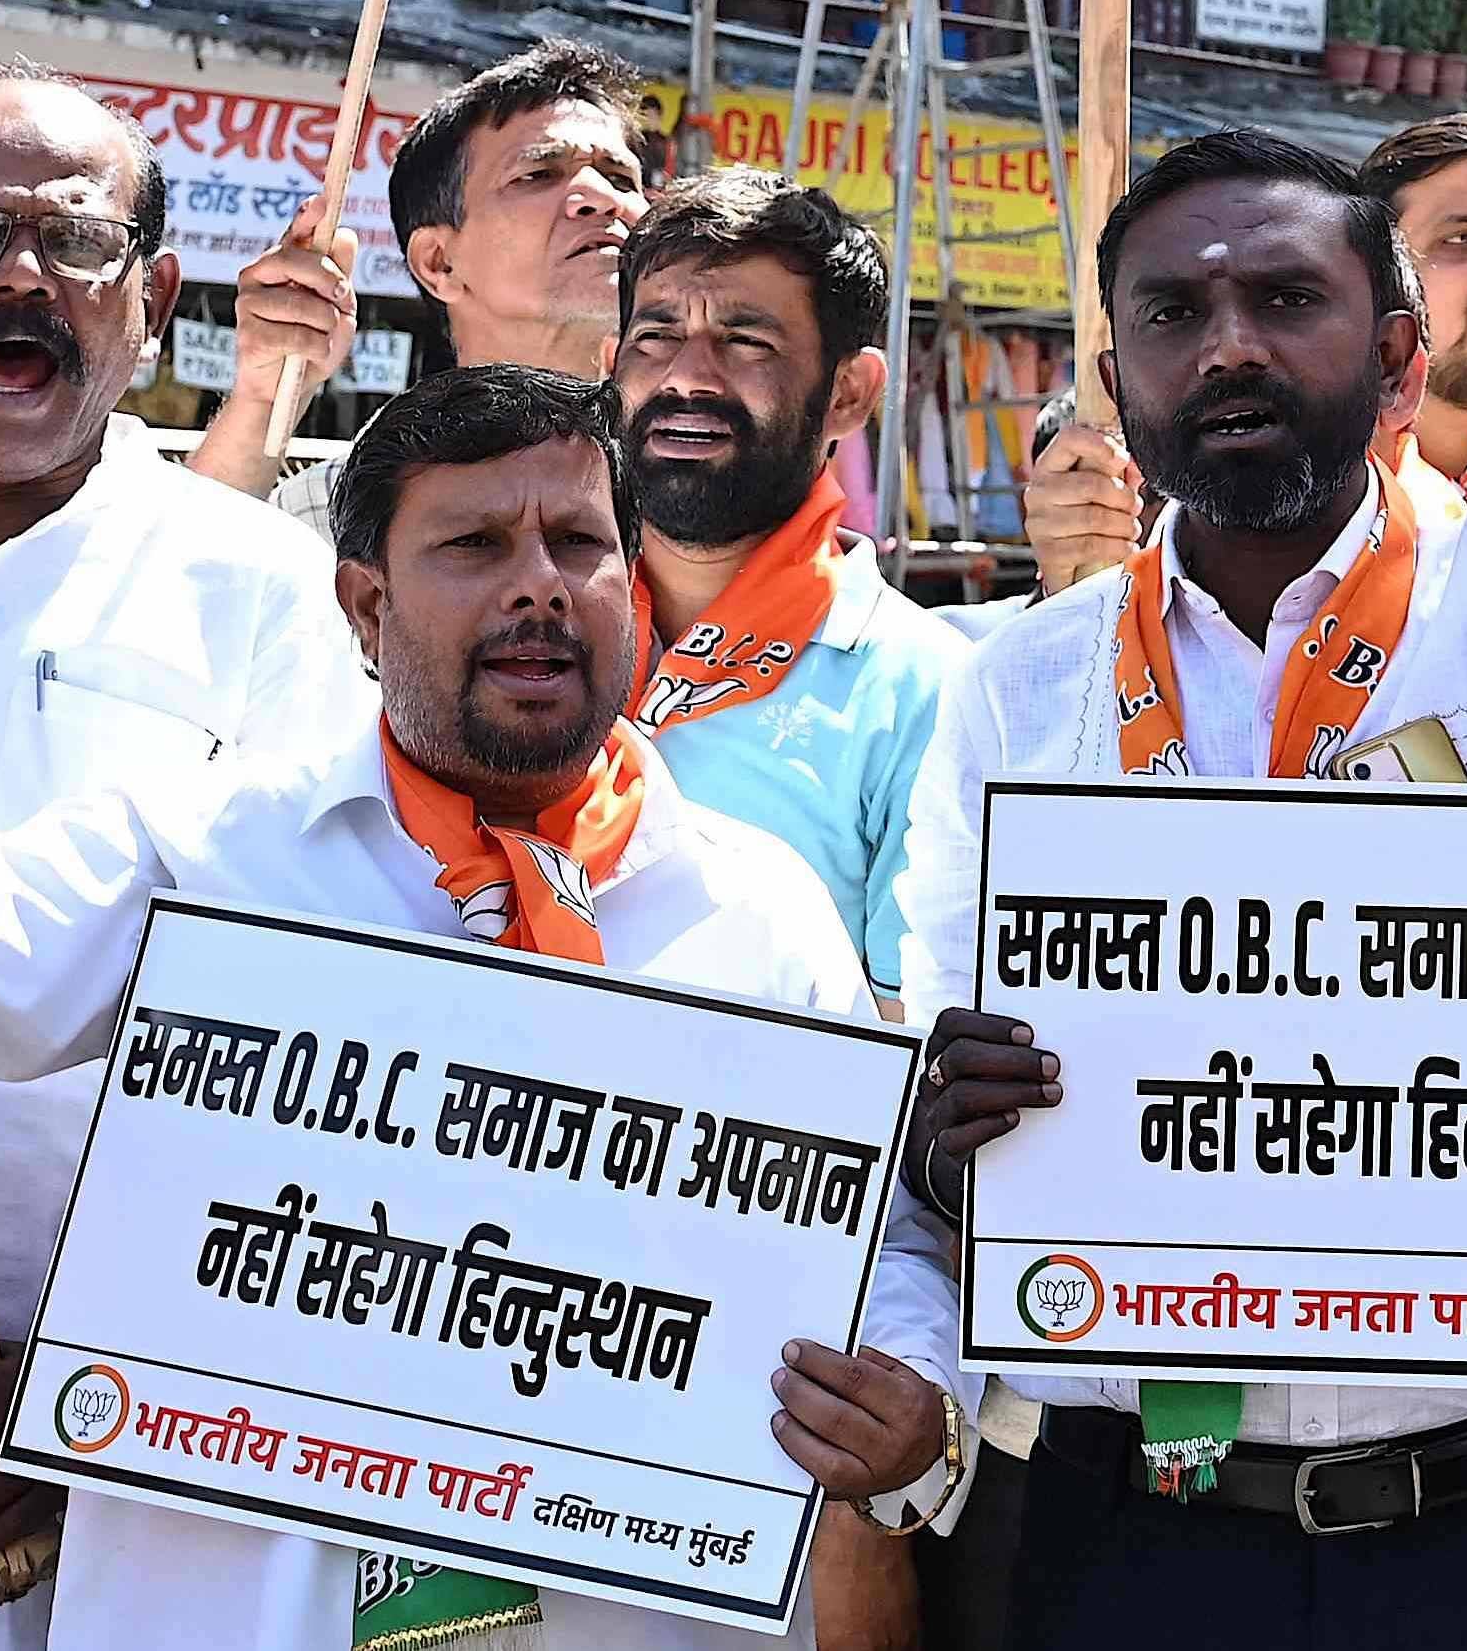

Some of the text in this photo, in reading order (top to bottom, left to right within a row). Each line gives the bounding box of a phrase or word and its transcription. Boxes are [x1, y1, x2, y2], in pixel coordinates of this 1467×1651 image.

[992, 892, 1167, 996] समस्त
[1175, 897, 1341, 998] O.B.C.
[119, 1004, 883, 1237] समस्त O.B.C. समाज का अपमान
[1135, 1048, 1254, 1176] नहीं
[1250, 1050, 1400, 1183] सहेगा
[194, 1181, 714, 1399] नहीं सहेगा हिन्दुस्थान
[1111, 1271, 1283, 1333] भारतीय
[1291, 1287, 1421, 1335] जनता
[133, 1390, 756, 1569] भारतीय जनता पार्टी दक्षिण मध्य मुंबई
